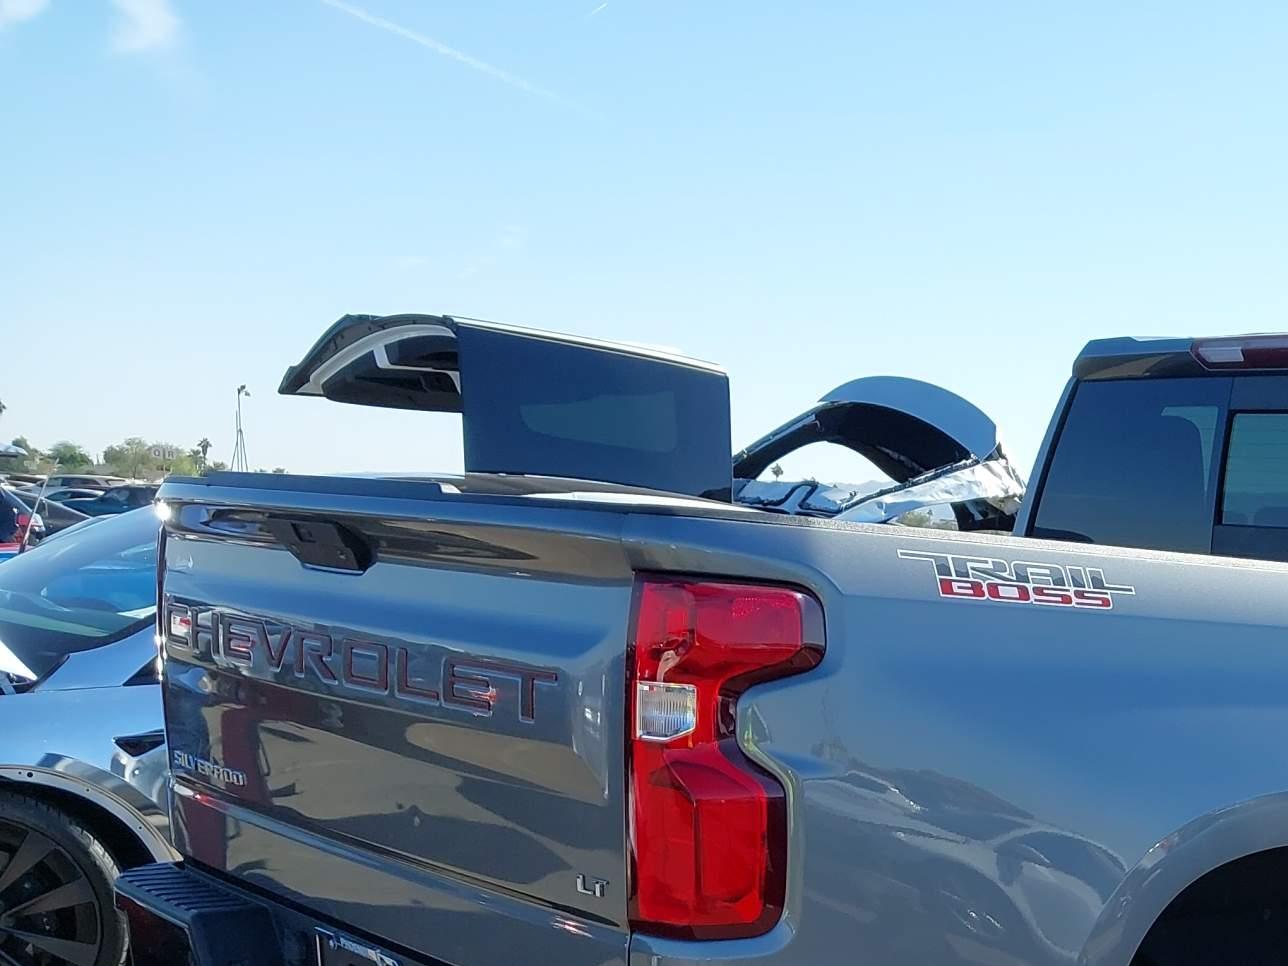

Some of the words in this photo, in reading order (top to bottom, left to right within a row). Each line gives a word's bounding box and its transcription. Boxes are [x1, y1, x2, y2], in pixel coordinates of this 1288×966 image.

[896, 548, 1137, 595] TRAIL
[938, 577, 1113, 610] BOSS
[165, 601, 559, 724] CHEVROLET
[173, 749, 247, 786] SILVERADO
[576, 873, 610, 898] LT
